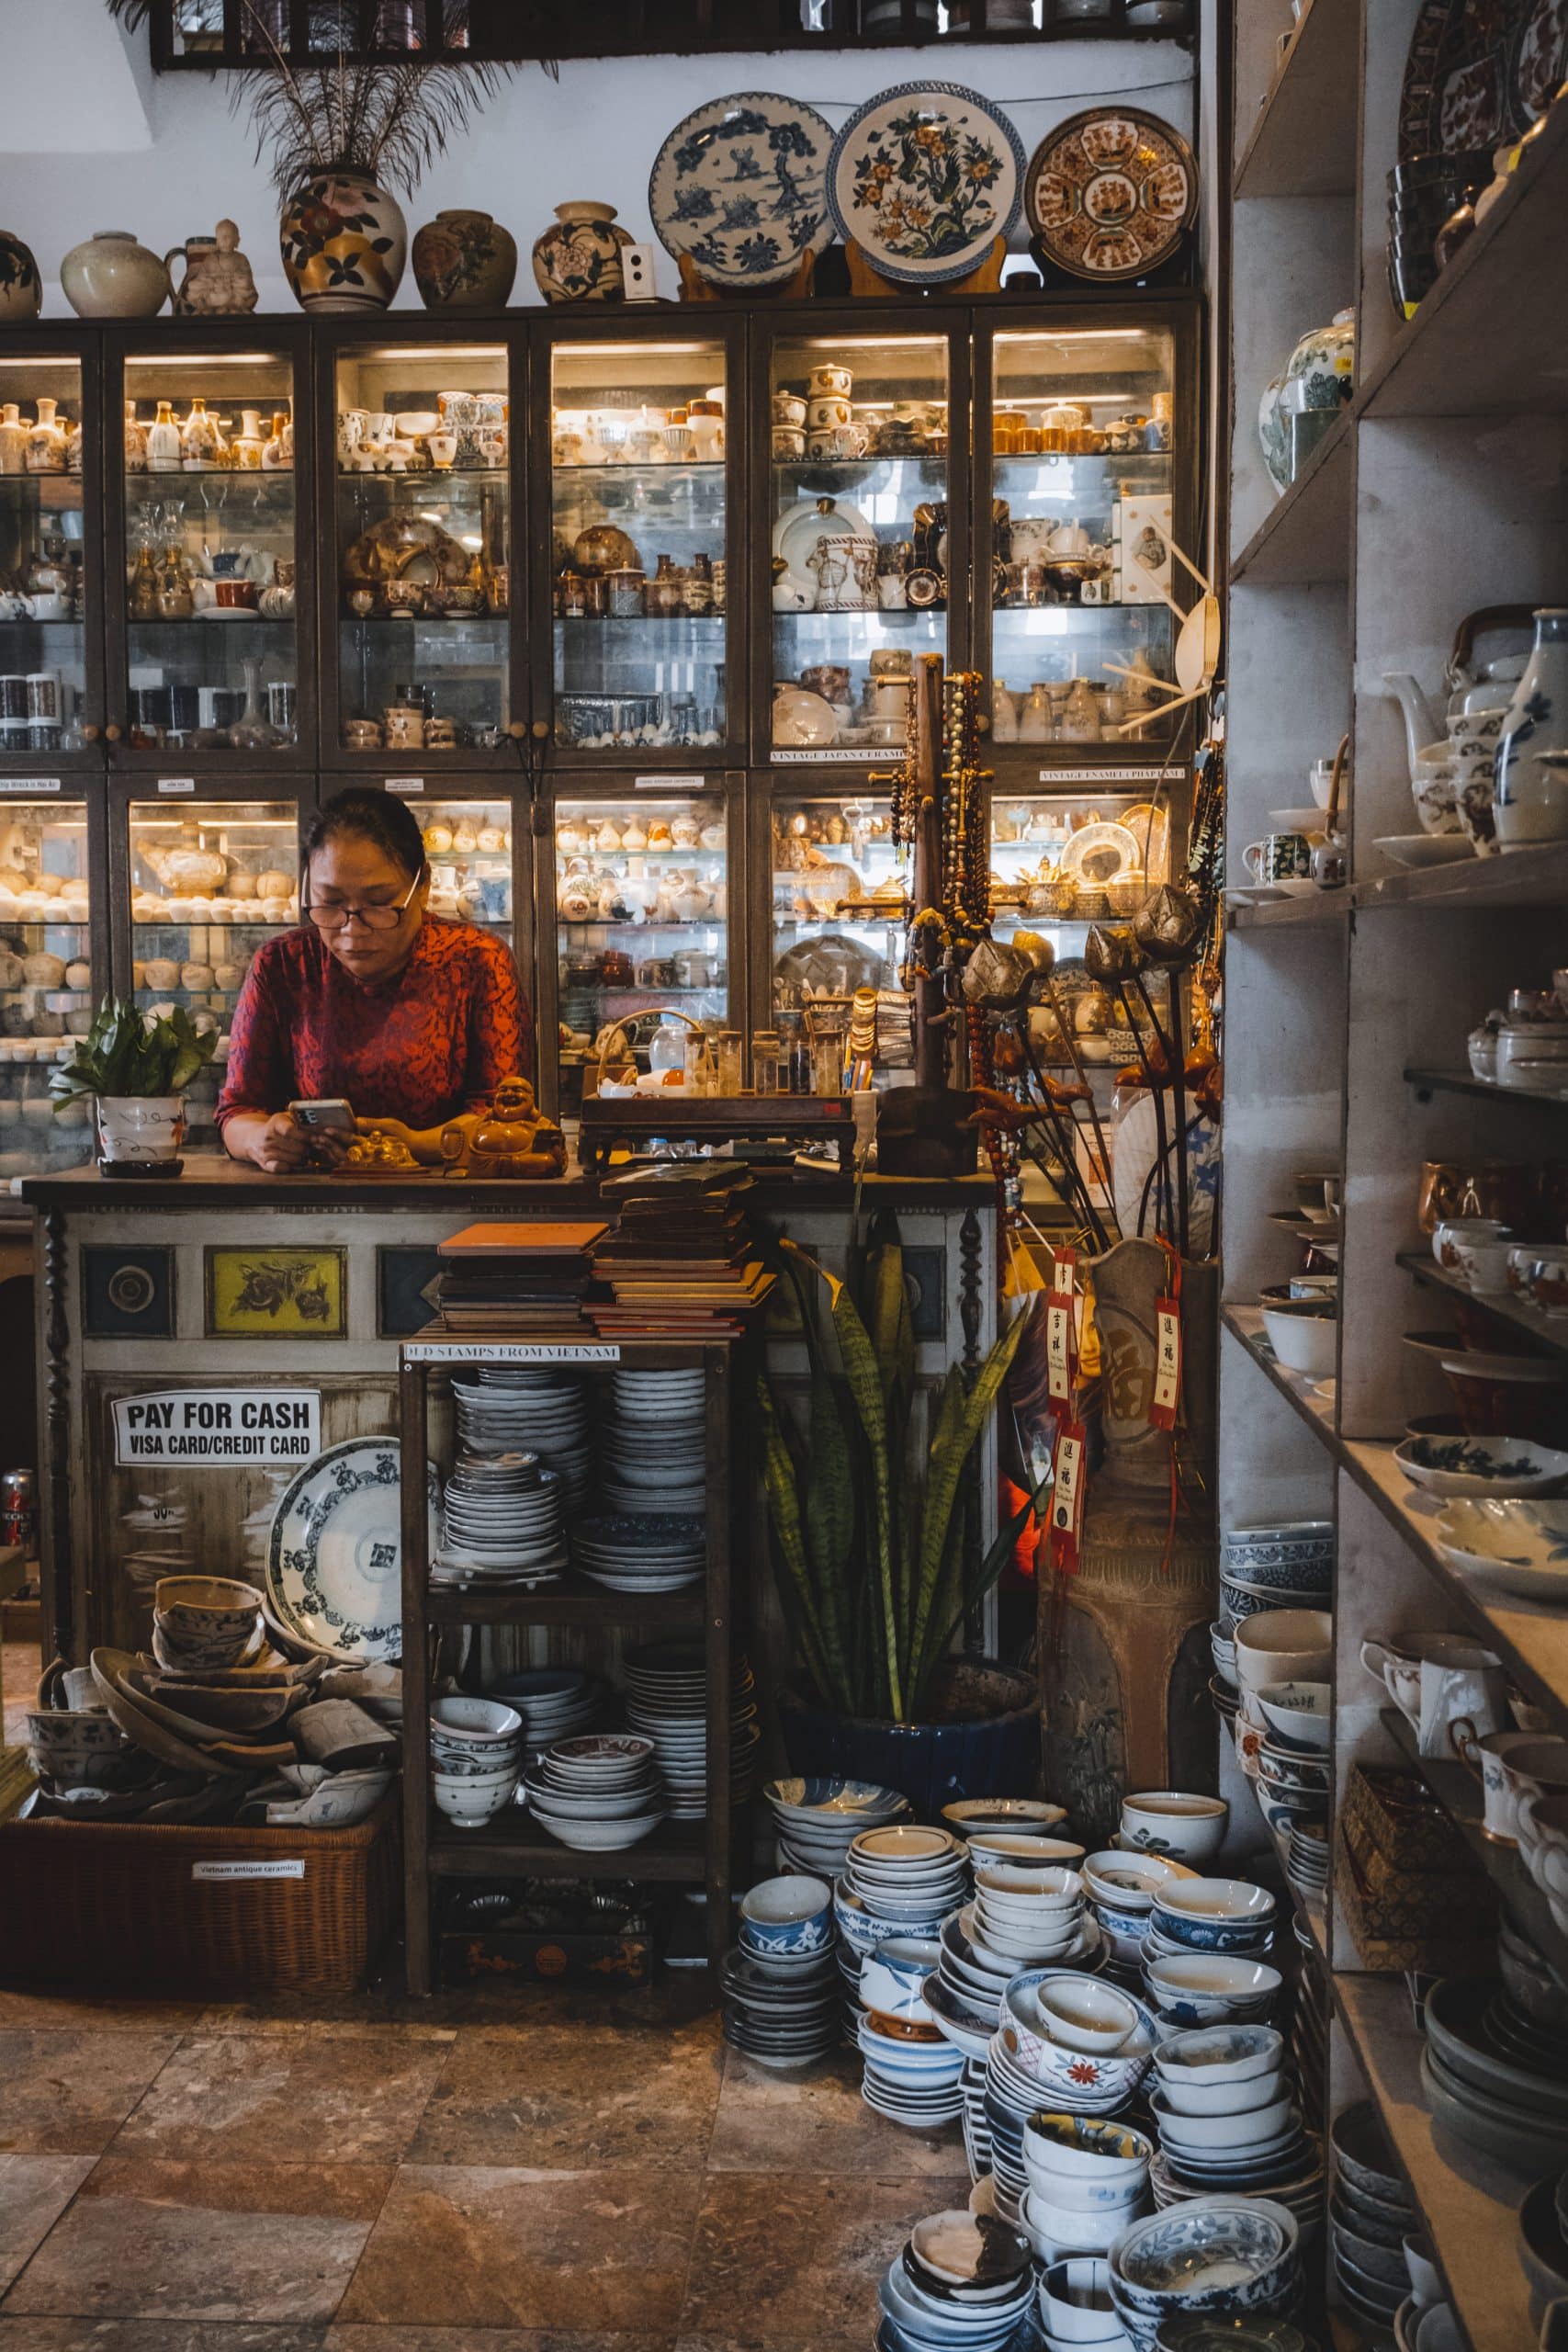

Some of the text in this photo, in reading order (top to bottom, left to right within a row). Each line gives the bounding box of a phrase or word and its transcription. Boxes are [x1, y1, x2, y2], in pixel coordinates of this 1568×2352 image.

[772, 750, 904, 760] VINTAGE JAPAN CERAMI
[1043, 771, 1083, 779] VINTAGE
[1086, 771, 1123, 779] ENAMEL
[437, 1347, 495, 1357] STAMPS
[500, 1347, 542, 1358] FROM
[547, 1347, 616, 1358] VIETNAM
[127, 1402, 310, 1430] PAY FOR CASH
[130, 1435, 310, 1455] VISA CARD/CREDIT CARD
[201, 1864, 299, 1875] Vietnam antique ceramics
